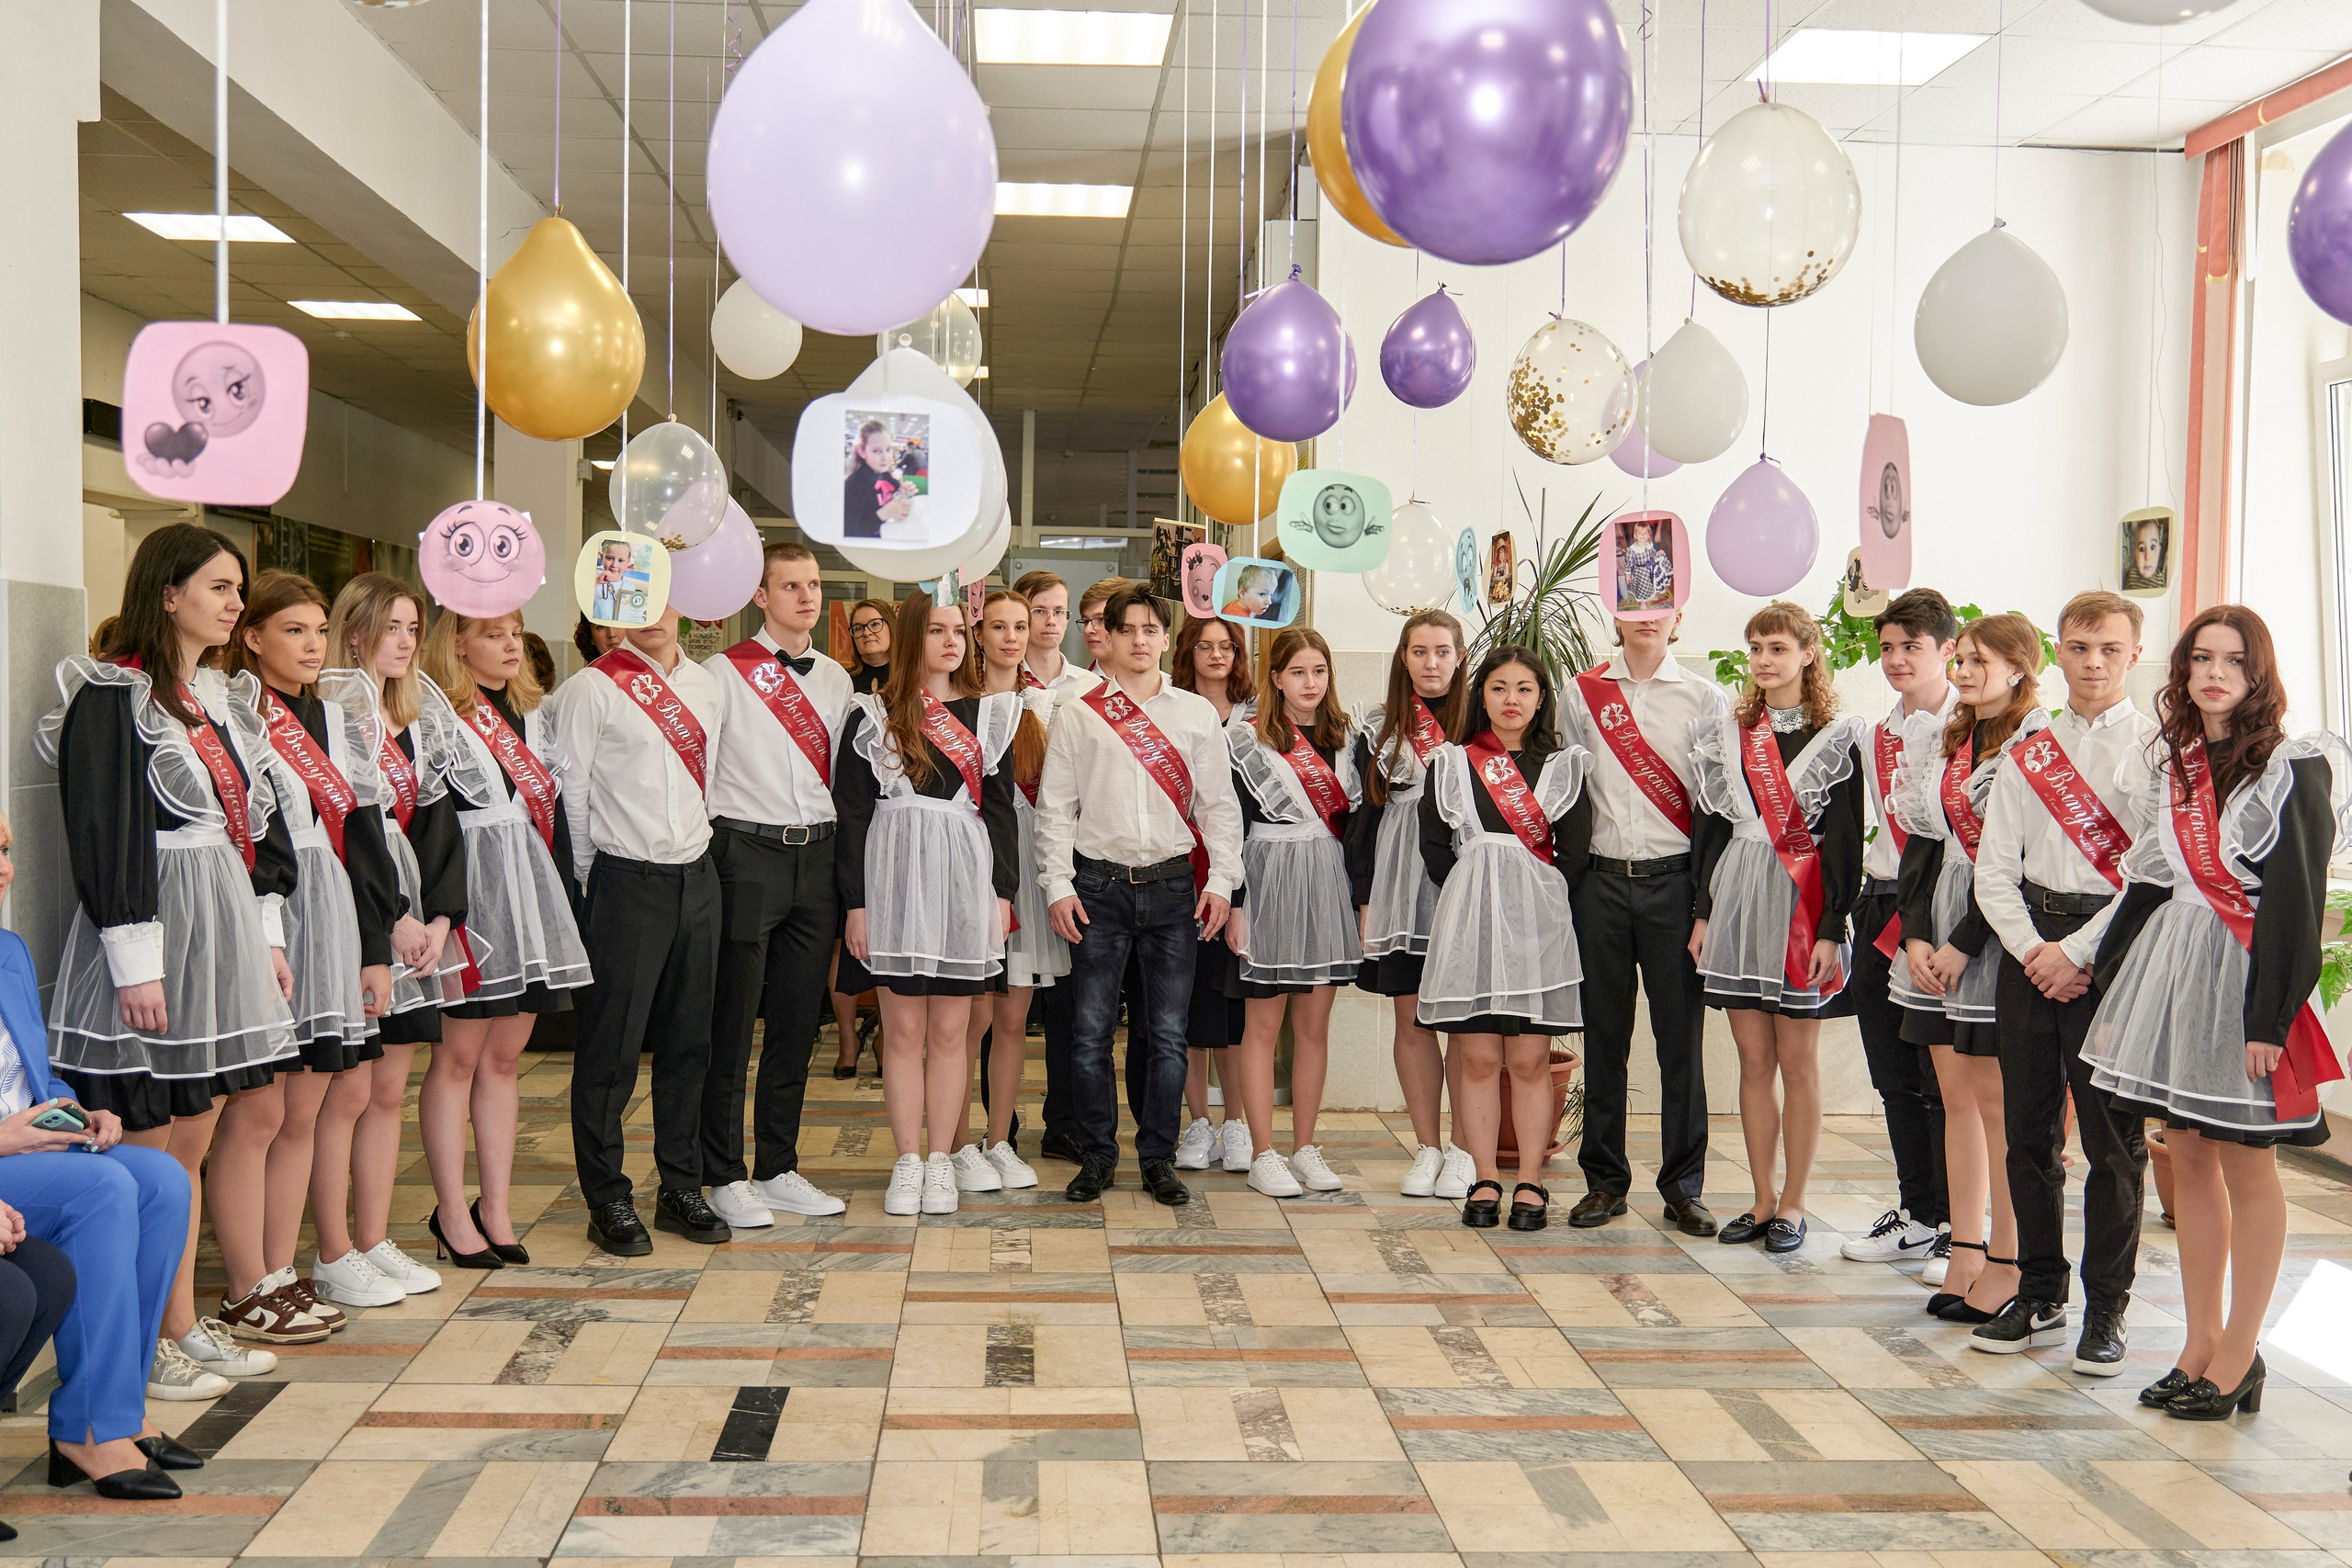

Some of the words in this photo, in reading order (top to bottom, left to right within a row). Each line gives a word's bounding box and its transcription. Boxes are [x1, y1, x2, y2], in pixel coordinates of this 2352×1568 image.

[1124, 715, 1187, 796] Выпускник
[1748, 724, 1789, 824] Выпускница
[1781, 823, 1815, 863] 2024
[2043, 764, 2120, 866] Выпускни
